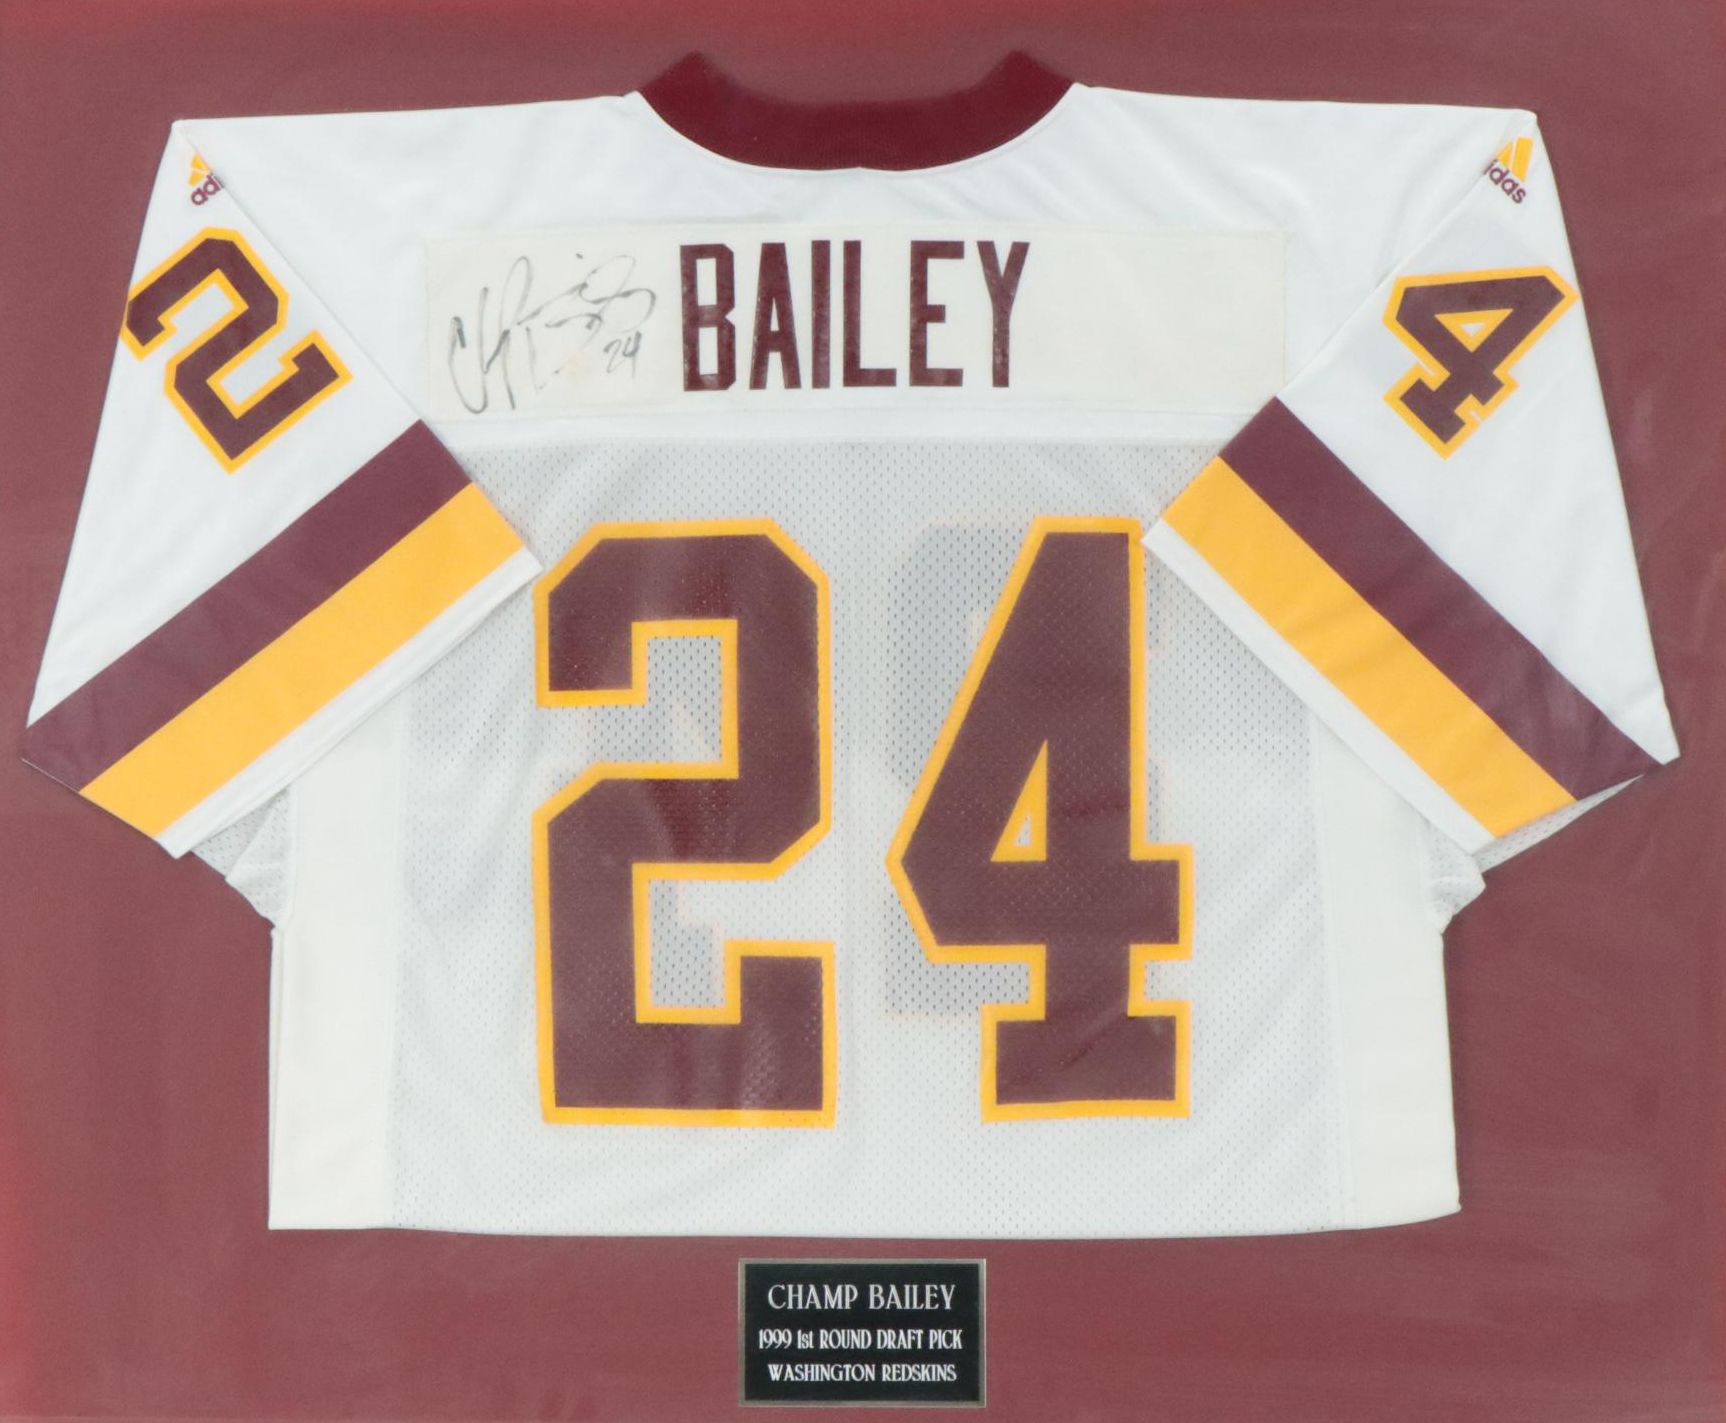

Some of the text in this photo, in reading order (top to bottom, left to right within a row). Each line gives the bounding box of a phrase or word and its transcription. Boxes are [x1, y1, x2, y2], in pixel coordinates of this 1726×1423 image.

[119, 226, 354, 474] 2
[680, 240, 1030, 391] BAILEY
[1381, 265, 1580, 461] 4
[531, 515, 1193, 1128] 24
[758, 1329, 963, 1350] 1999 1st ROUND DRAFT PICK
[767, 1284, 956, 1311] CHAMP BAILEY
[767, 1364, 958, 1382] WASHINGTON REDSKINS
